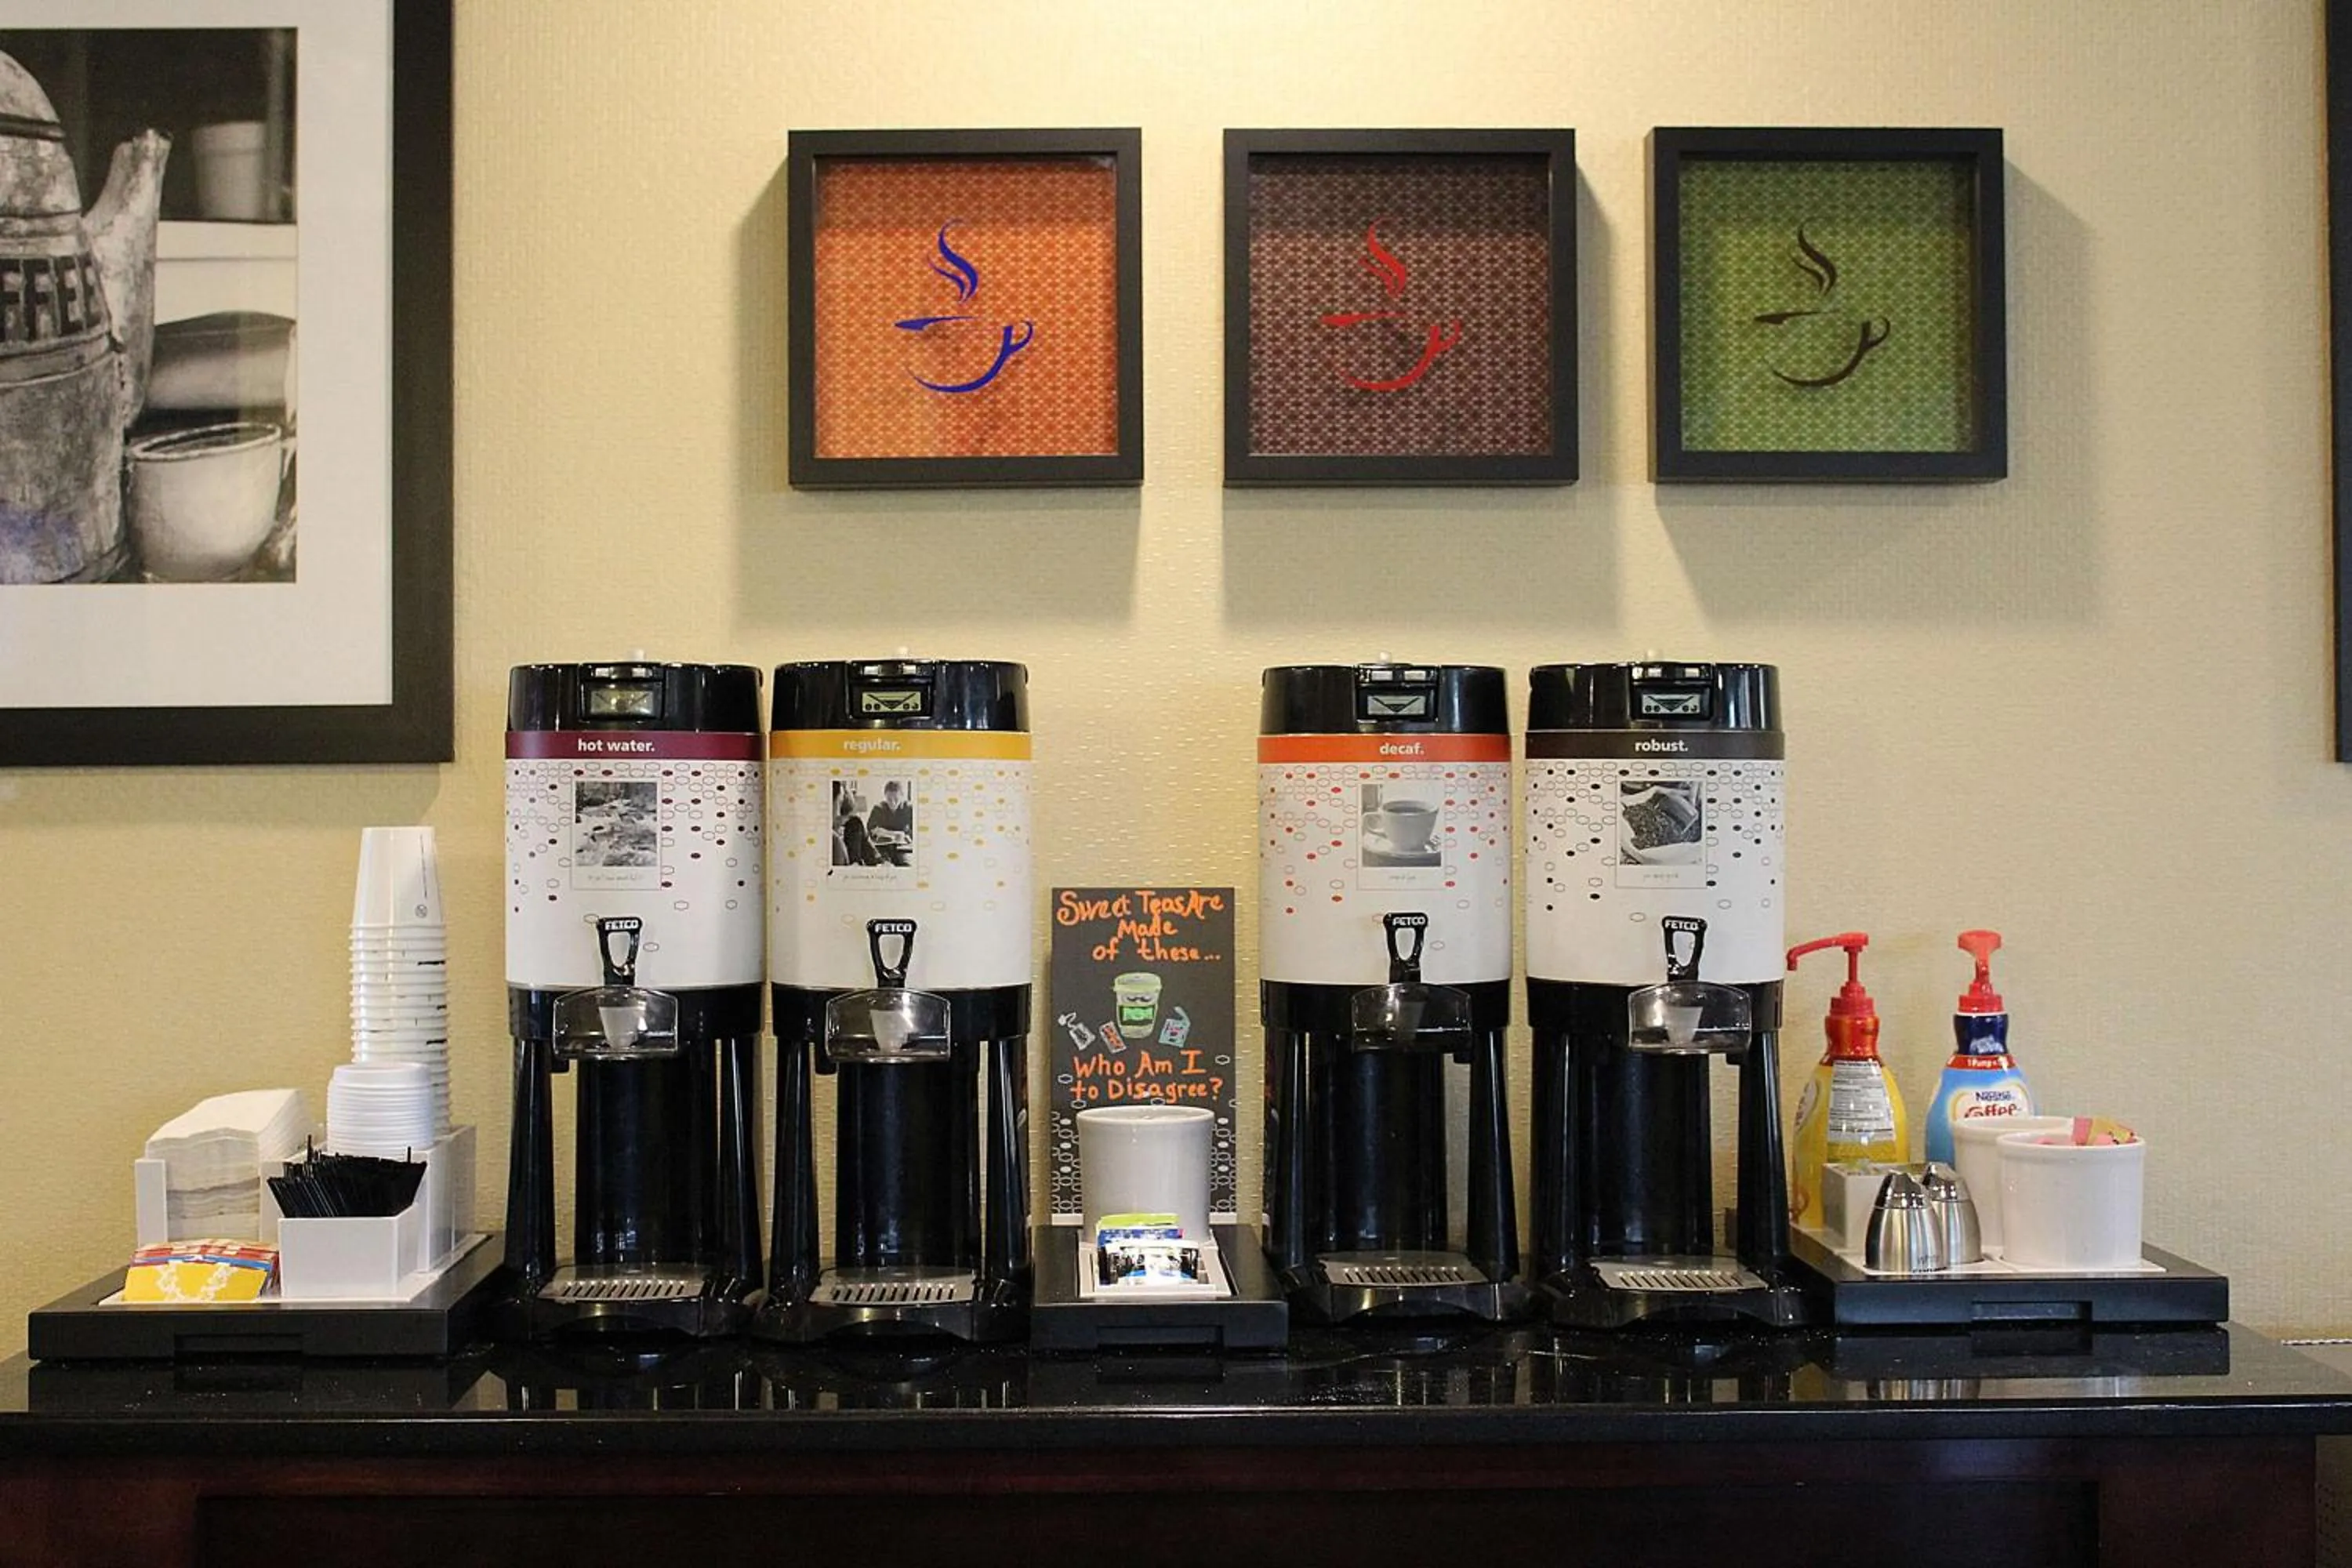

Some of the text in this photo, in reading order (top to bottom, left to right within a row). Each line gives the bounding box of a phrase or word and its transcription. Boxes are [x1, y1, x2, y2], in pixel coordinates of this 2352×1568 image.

[578, 738, 655, 752] hot water.
[844, 737, 900, 753] regular.
[1379, 742, 1425, 755] decaf.
[1635, 739, 1689, 752] robust.
[1057, 890, 1132, 926] Sweet
[604, 920, 639, 931] FETCO
[874, 923, 912, 933] FETCO
[1392, 916, 1426, 926] FETCO
[1664, 920, 1699, 931] FETCO
[1117, 916, 1178, 943] Made
[1092, 936, 1120, 961] of
[1073, 1049, 1207, 1078] Who Am I
[1070, 1077, 1224, 1105] to Disagree?
